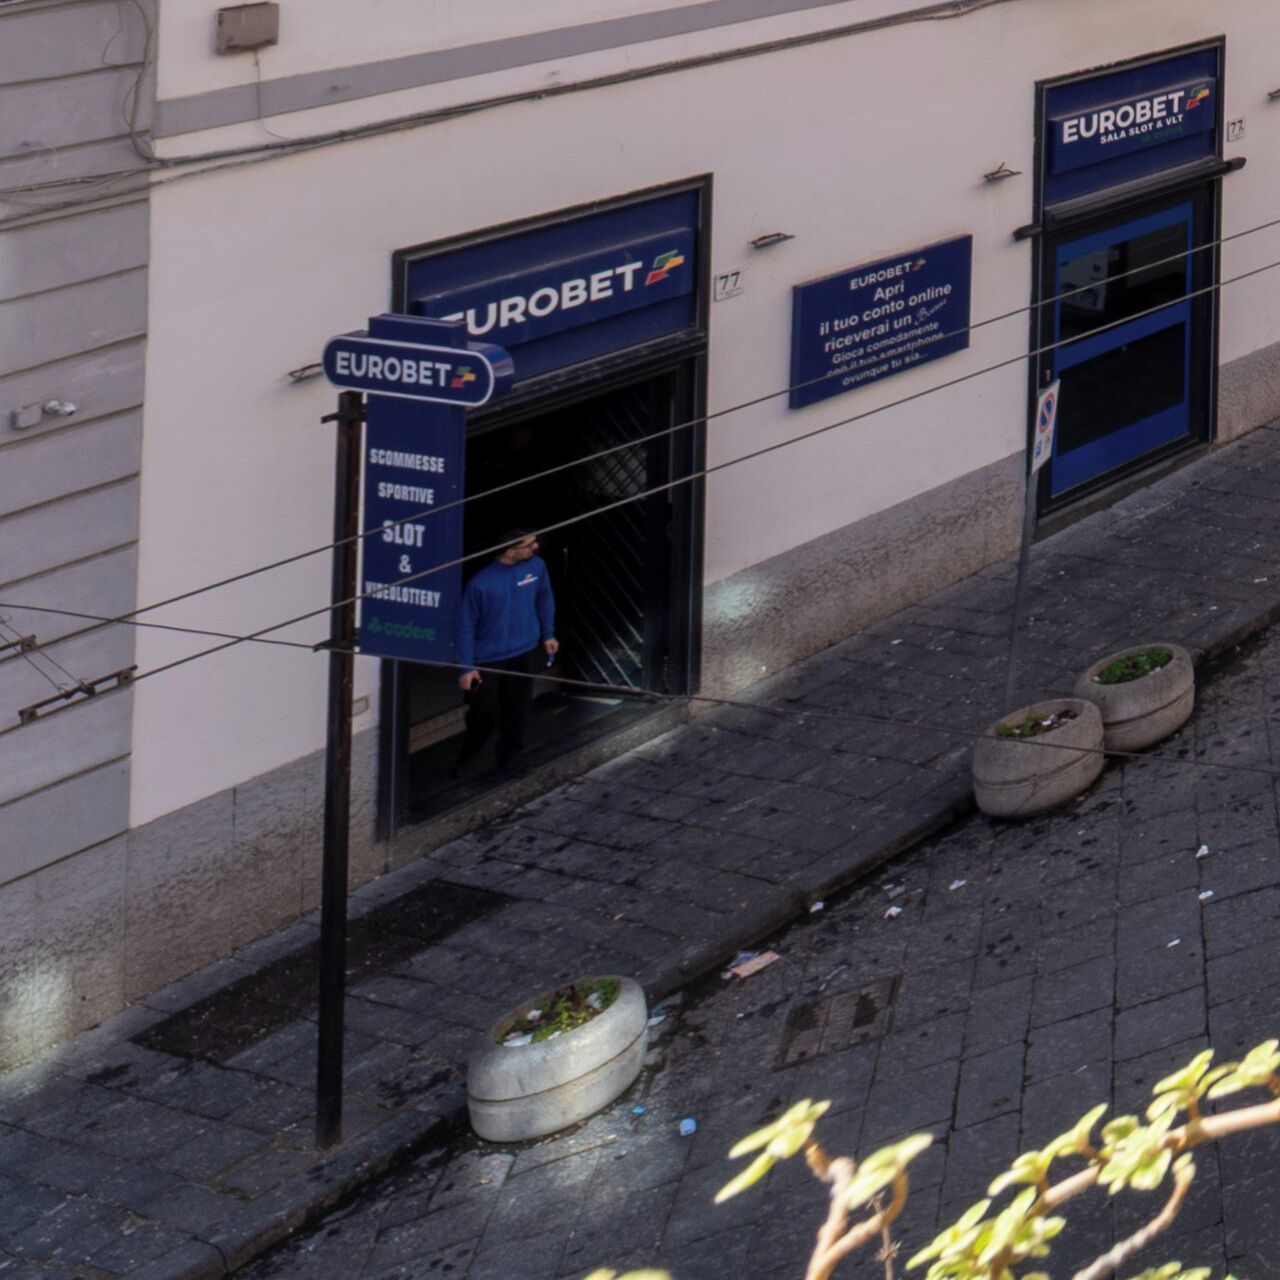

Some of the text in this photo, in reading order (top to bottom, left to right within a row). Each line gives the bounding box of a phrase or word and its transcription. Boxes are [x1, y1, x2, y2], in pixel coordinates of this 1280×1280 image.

[1063, 91, 1185, 144] EUROBET
[1100, 131, 1126, 145] SALA
[1129, 123, 1153, 137] SLOT
[1156, 120, 1163, 129] &
[1166, 114, 1184, 126] VLT
[719, 271, 741, 291] 77
[850, 261, 912, 290] EUROBET
[440, 261, 643, 335] UROBET
[873, 280, 905, 301] Apri
[820, 284, 952, 336] il tuo conto online
[824, 320, 889, 352] riceverai
[894, 315, 912, 329] un
[832, 322, 939, 364] Gioca comodamente
[335, 350, 451, 387] EUROBET
[842, 363, 889, 386] ovunque
[892, 358, 902, 369] tu
[370, 448, 445, 473] SCOMMESSE
[378, 481, 434, 505] SPORTIVE
[382, 520, 426, 547] SLOT
[398, 554, 412, 573] &
[365, 581, 441, 608] VIDEOLOTTERY
